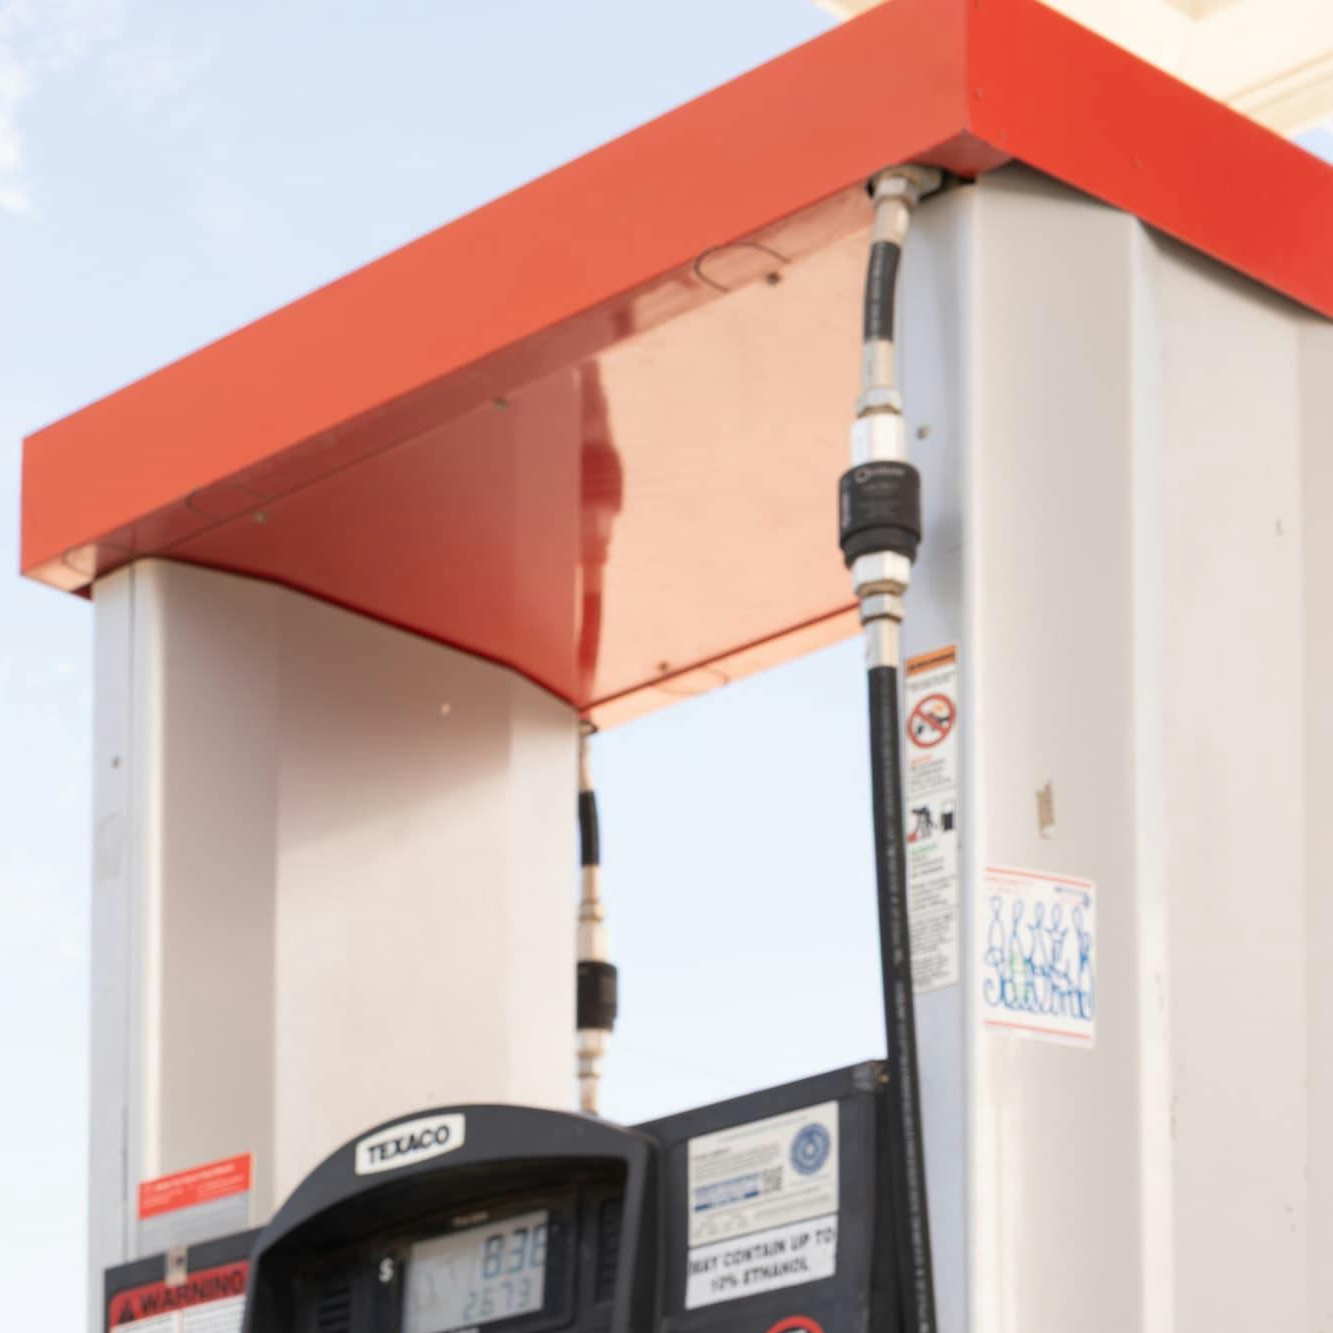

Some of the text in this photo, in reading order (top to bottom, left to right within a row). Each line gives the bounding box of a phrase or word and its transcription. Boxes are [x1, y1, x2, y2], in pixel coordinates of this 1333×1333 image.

[369, 1126, 449, 1164] TEXACO
[723, 1240, 785, 1267] CONTAIN
[791, 1234, 810, 1251] UP
[815, 1227, 836, 1245] TO
[379, 1257, 394, 1283] $
[743, 1257, 808, 1285] ETHANOL
[140, 1270, 244, 1314] WARNING
